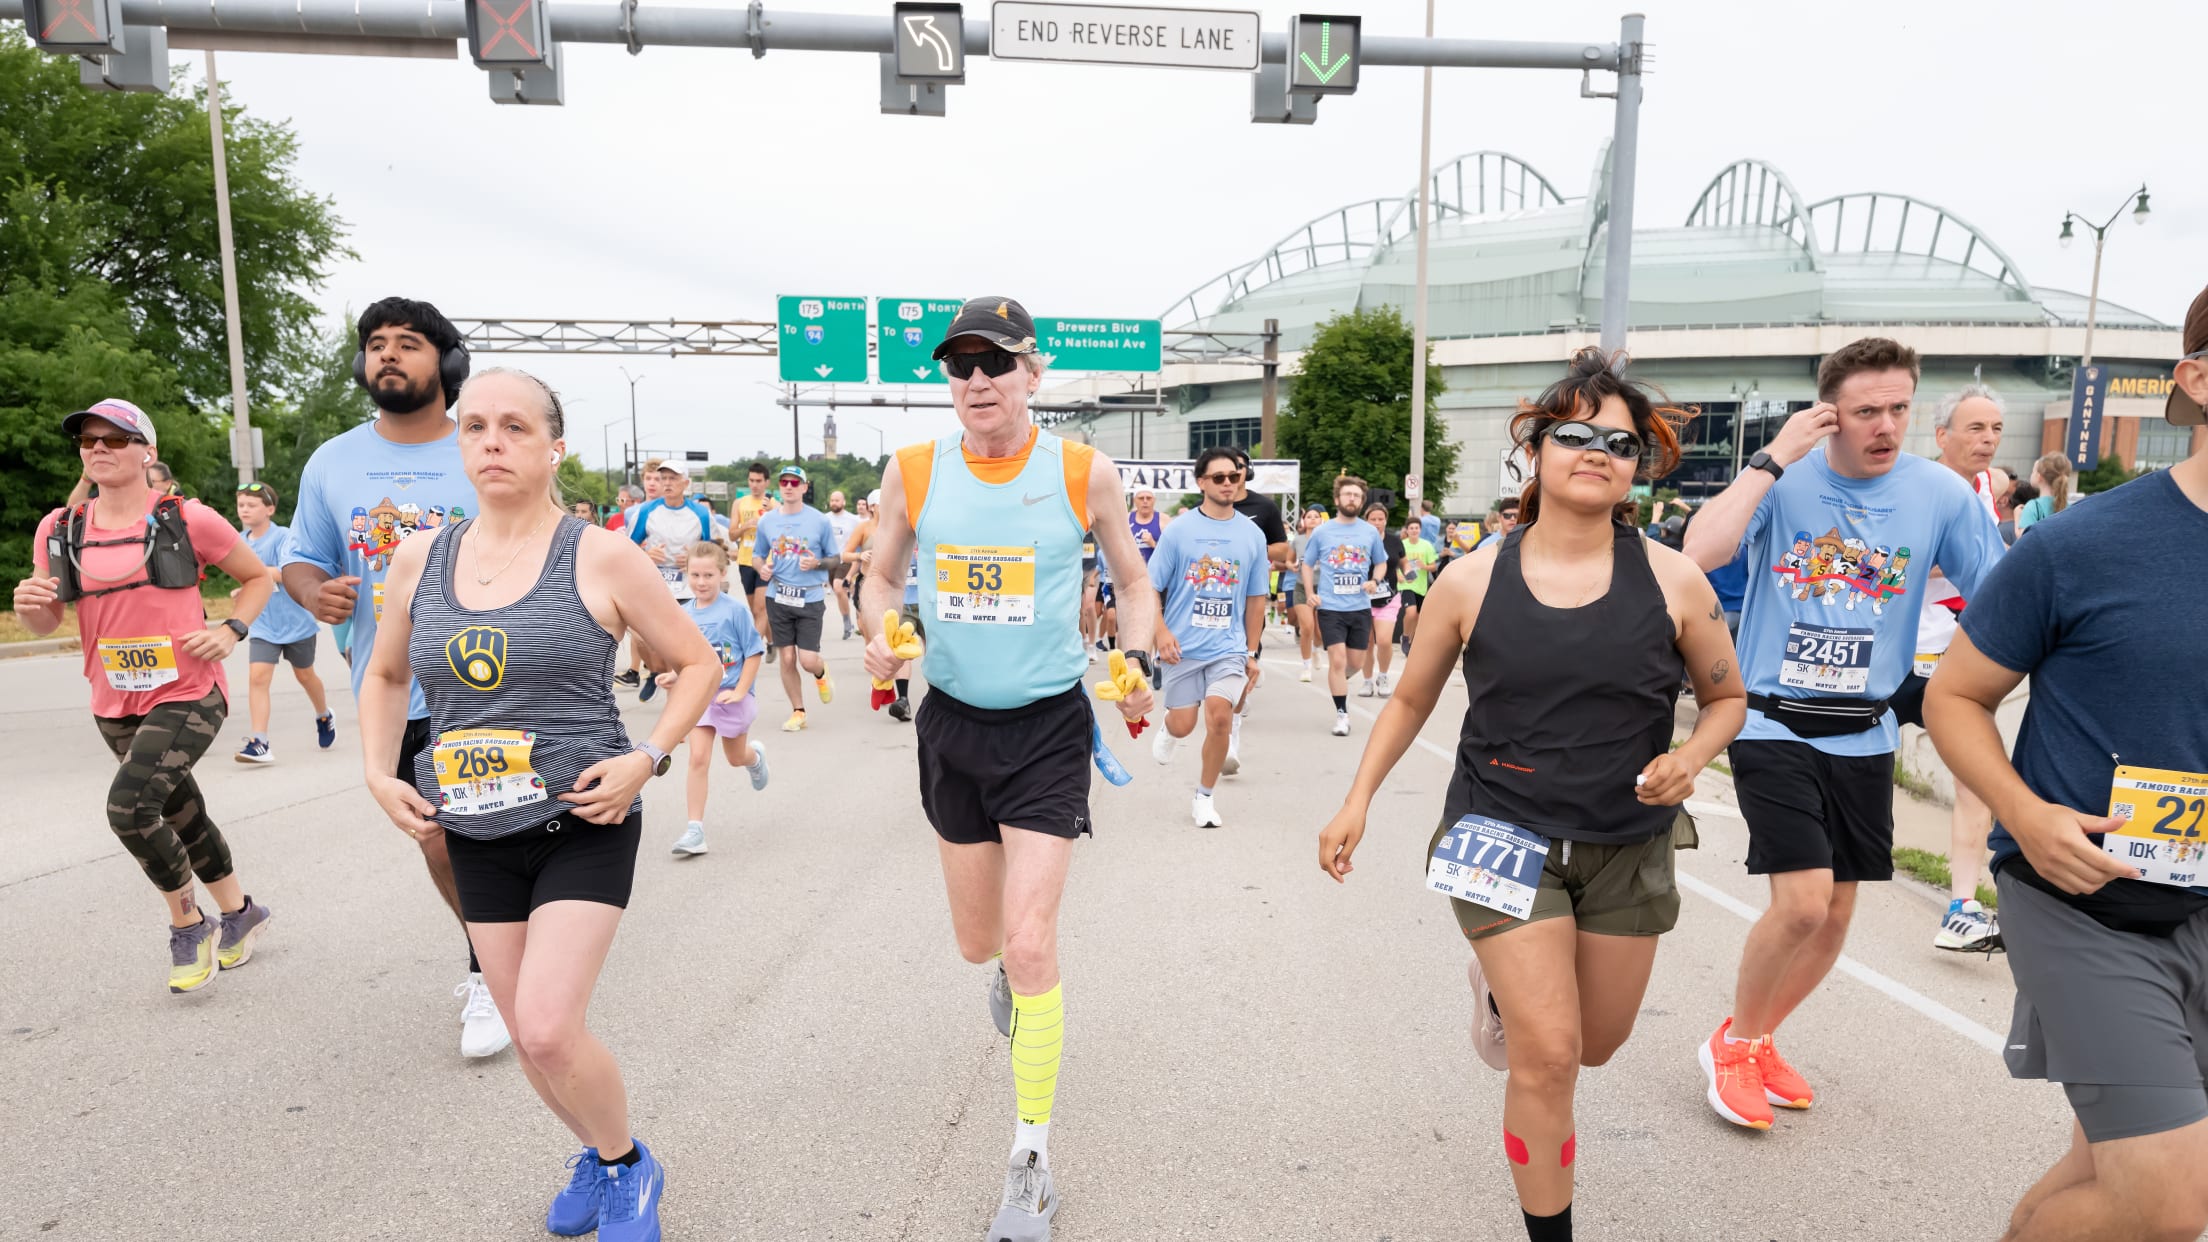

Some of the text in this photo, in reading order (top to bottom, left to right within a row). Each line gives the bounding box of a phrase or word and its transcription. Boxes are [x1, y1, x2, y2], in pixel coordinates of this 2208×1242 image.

[1018, 20, 1234, 50] END REVERSE LANE
[801, 301, 865, 315] 175 NORTH
[901, 305, 919, 317] 175
[1056, 321, 1140, 334] Brewers Blvd
[807, 331, 821, 341] 94
[906, 333, 920, 343] 94
[1047, 336, 1146, 349] To National Ave
[2077, 385, 2095, 464] GANTNER
[1117, 467, 1194, 490] TART
[1501, 486, 1521, 494] ONL
[383, 533, 391, 545] 5
[1791, 559, 1800, 569] 4
[1817, 565, 1827, 576] 5
[1838, 564, 1850, 576] 3
[967, 563, 1002, 591] 53
[1860, 567, 1875, 580] 2
[1339, 577, 1358, 585] 1110
[782, 585, 801, 598] 1911
[949, 595, 964, 607] 10K
[1200, 602, 1228, 616] 1518
[972, 614, 996, 622] WATER
[1799, 637, 1860, 666] 2451
[116, 648, 158, 669] 306
[1796, 663, 1810, 673] 5K
[454, 746, 509, 779] 269
[451, 786, 468, 800] 10K
[2135, 781, 2176, 793] FAMOUS
[517, 793, 539, 803] BRAT
[478, 800, 505, 811] WATER
[2152, 795, 2206, 838] 22
[1458, 822, 1536, 849] FAMOUS RACING SAUSAGES
[1456, 831, 1527, 878] 1771
[2128, 841, 2158, 860] 10K
[1446, 862, 1462, 877] 5K
[1434, 881, 1454, 893] BEER
[1465, 890, 1491, 904] WATER
[1501, 902, 1523, 915] BRAT
